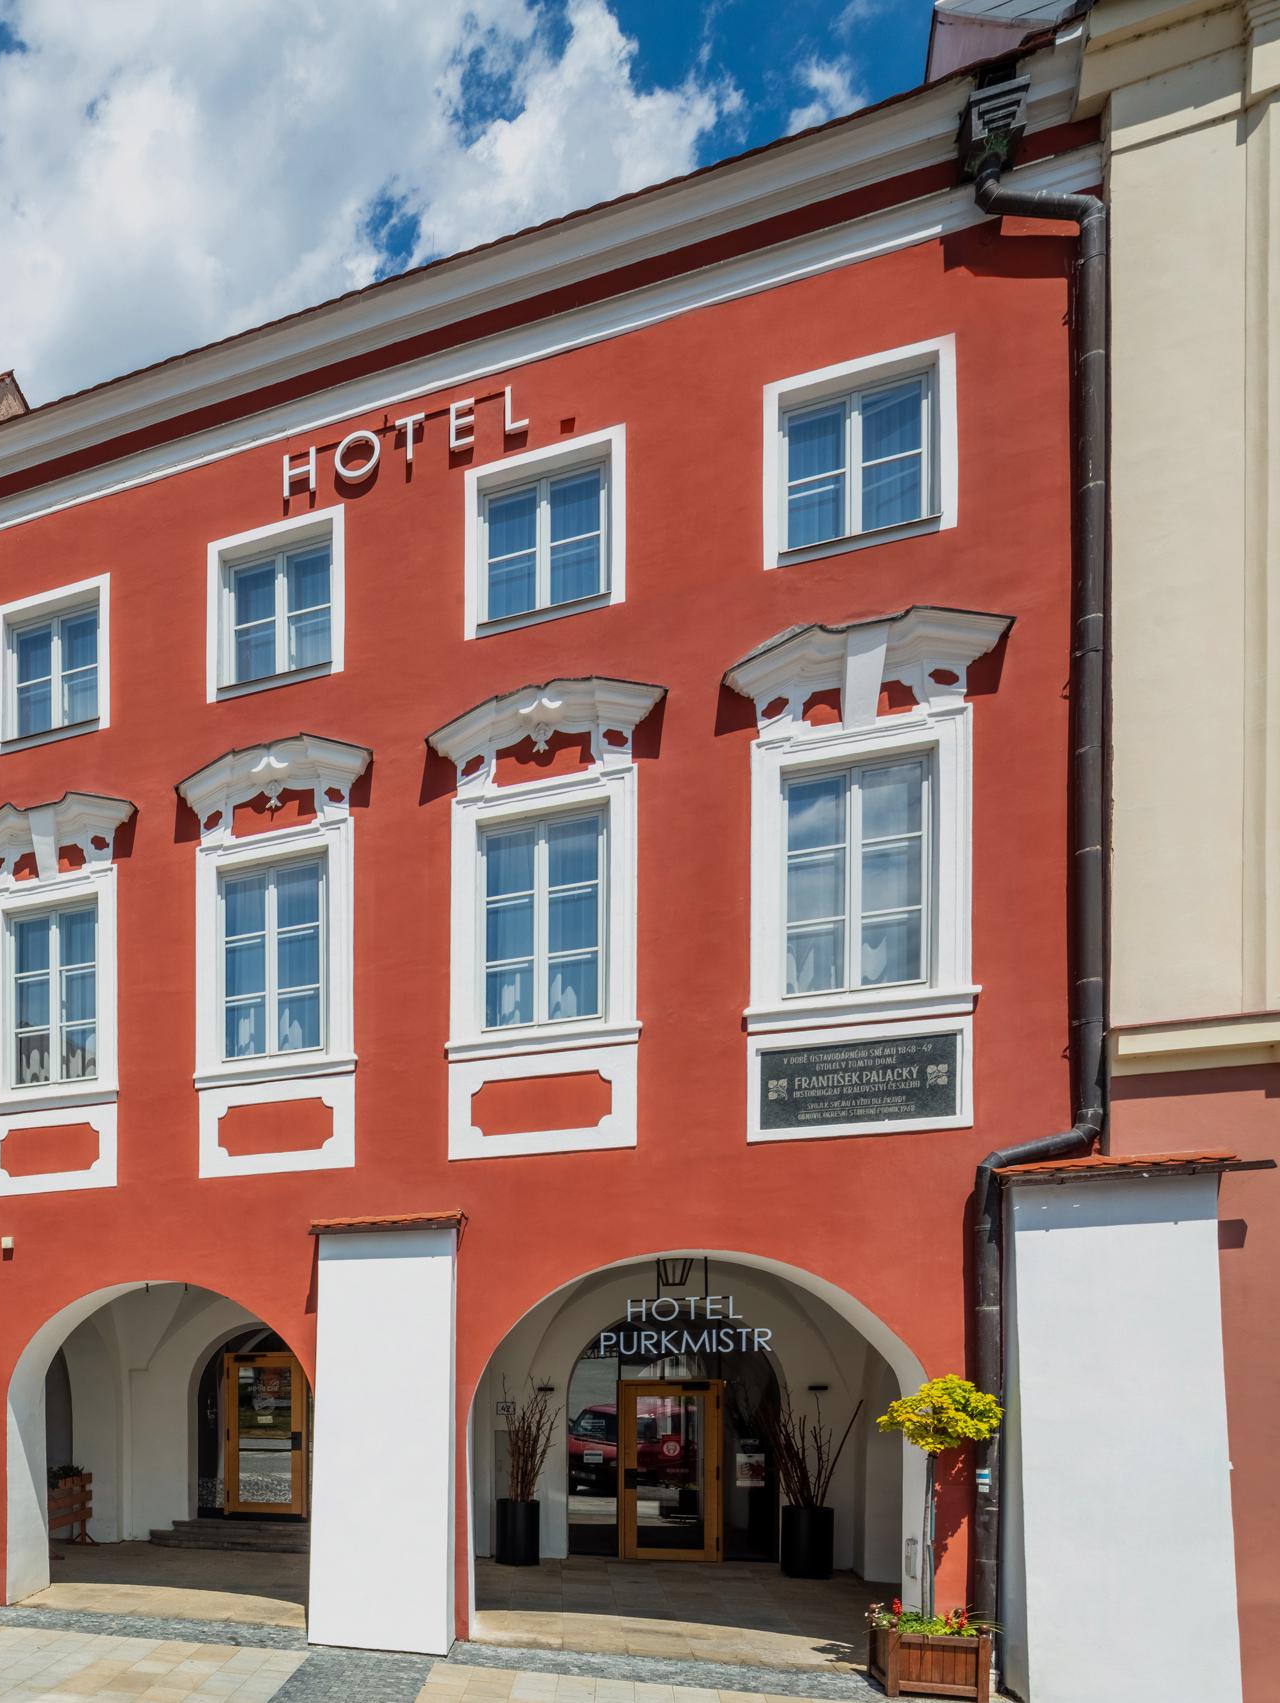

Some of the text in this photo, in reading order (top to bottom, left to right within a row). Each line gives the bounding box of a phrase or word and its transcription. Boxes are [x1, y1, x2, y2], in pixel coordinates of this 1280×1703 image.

[283, 385, 529, 499] HOTEL
[794, 1064, 919, 1090] FRANTIŠEK PALACKÝ
[627, 1296, 743, 1322] HOTEL
[600, 1328, 773, 1355] PURKMISTR
